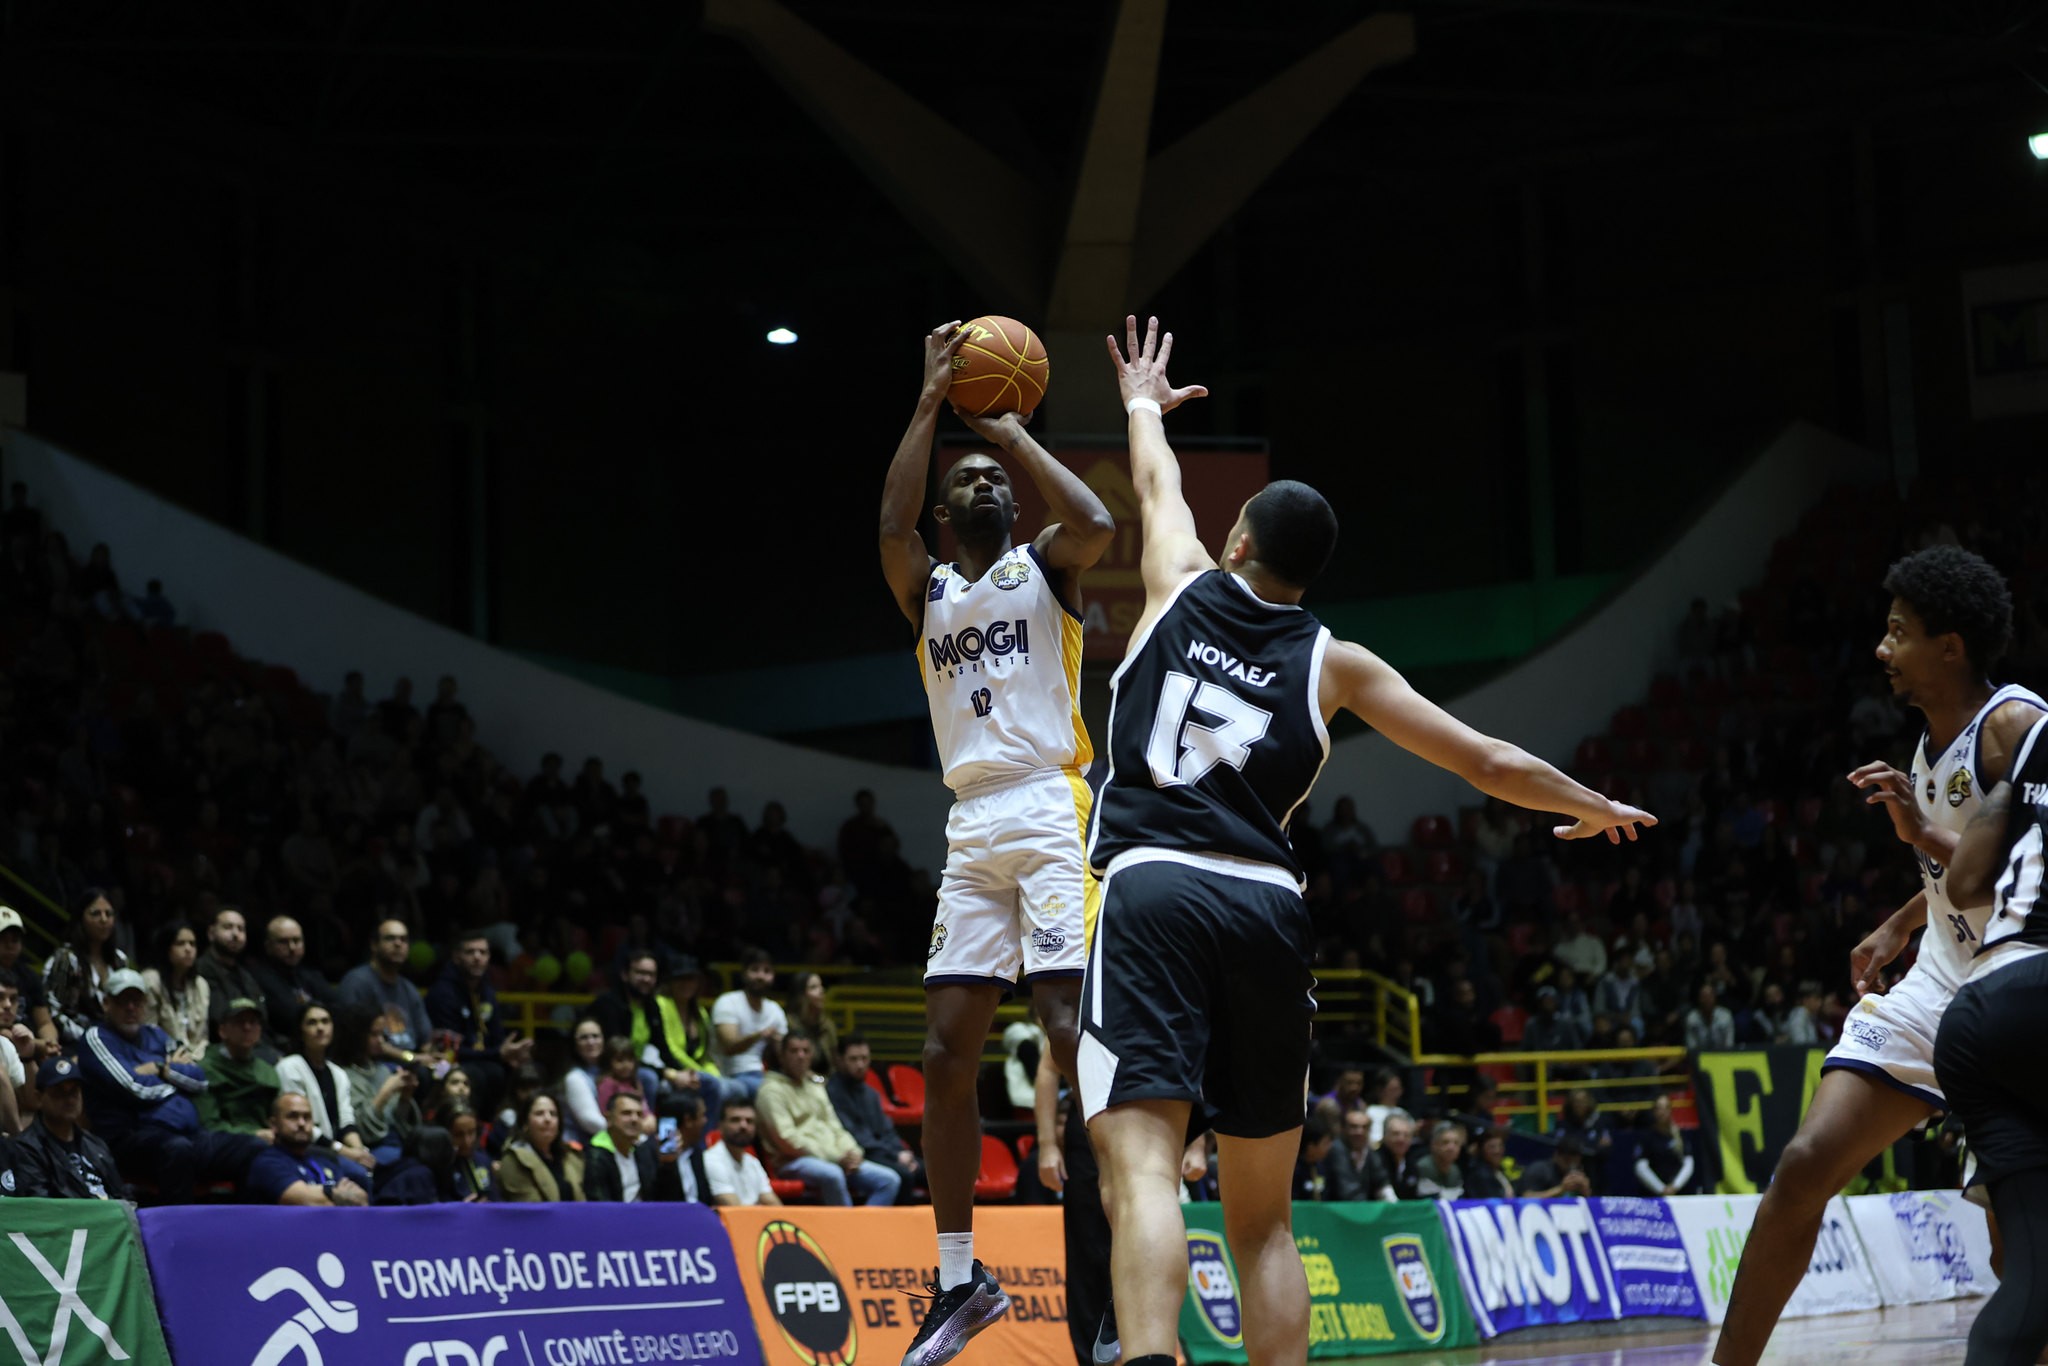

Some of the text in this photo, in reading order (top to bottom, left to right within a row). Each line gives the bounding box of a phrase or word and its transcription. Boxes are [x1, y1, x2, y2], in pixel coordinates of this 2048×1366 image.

[928, 619, 1030, 672] MOGI
[1186, 640, 1277, 688] NOVAES
[970, 687, 993, 718] 12
[1947, 913, 1977, 943] 31
[371, 1247, 718, 1305] FORMAÇÃO DE ATLETAS
[1456, 1203, 1601, 1312] IMOT
[773, 1280, 841, 1315] FPB
[860, 1298, 903, 1328] DE
[543, 1328, 634, 1366] COMITÊ
[633, 1329, 740, 1364] BRASILEIRO
